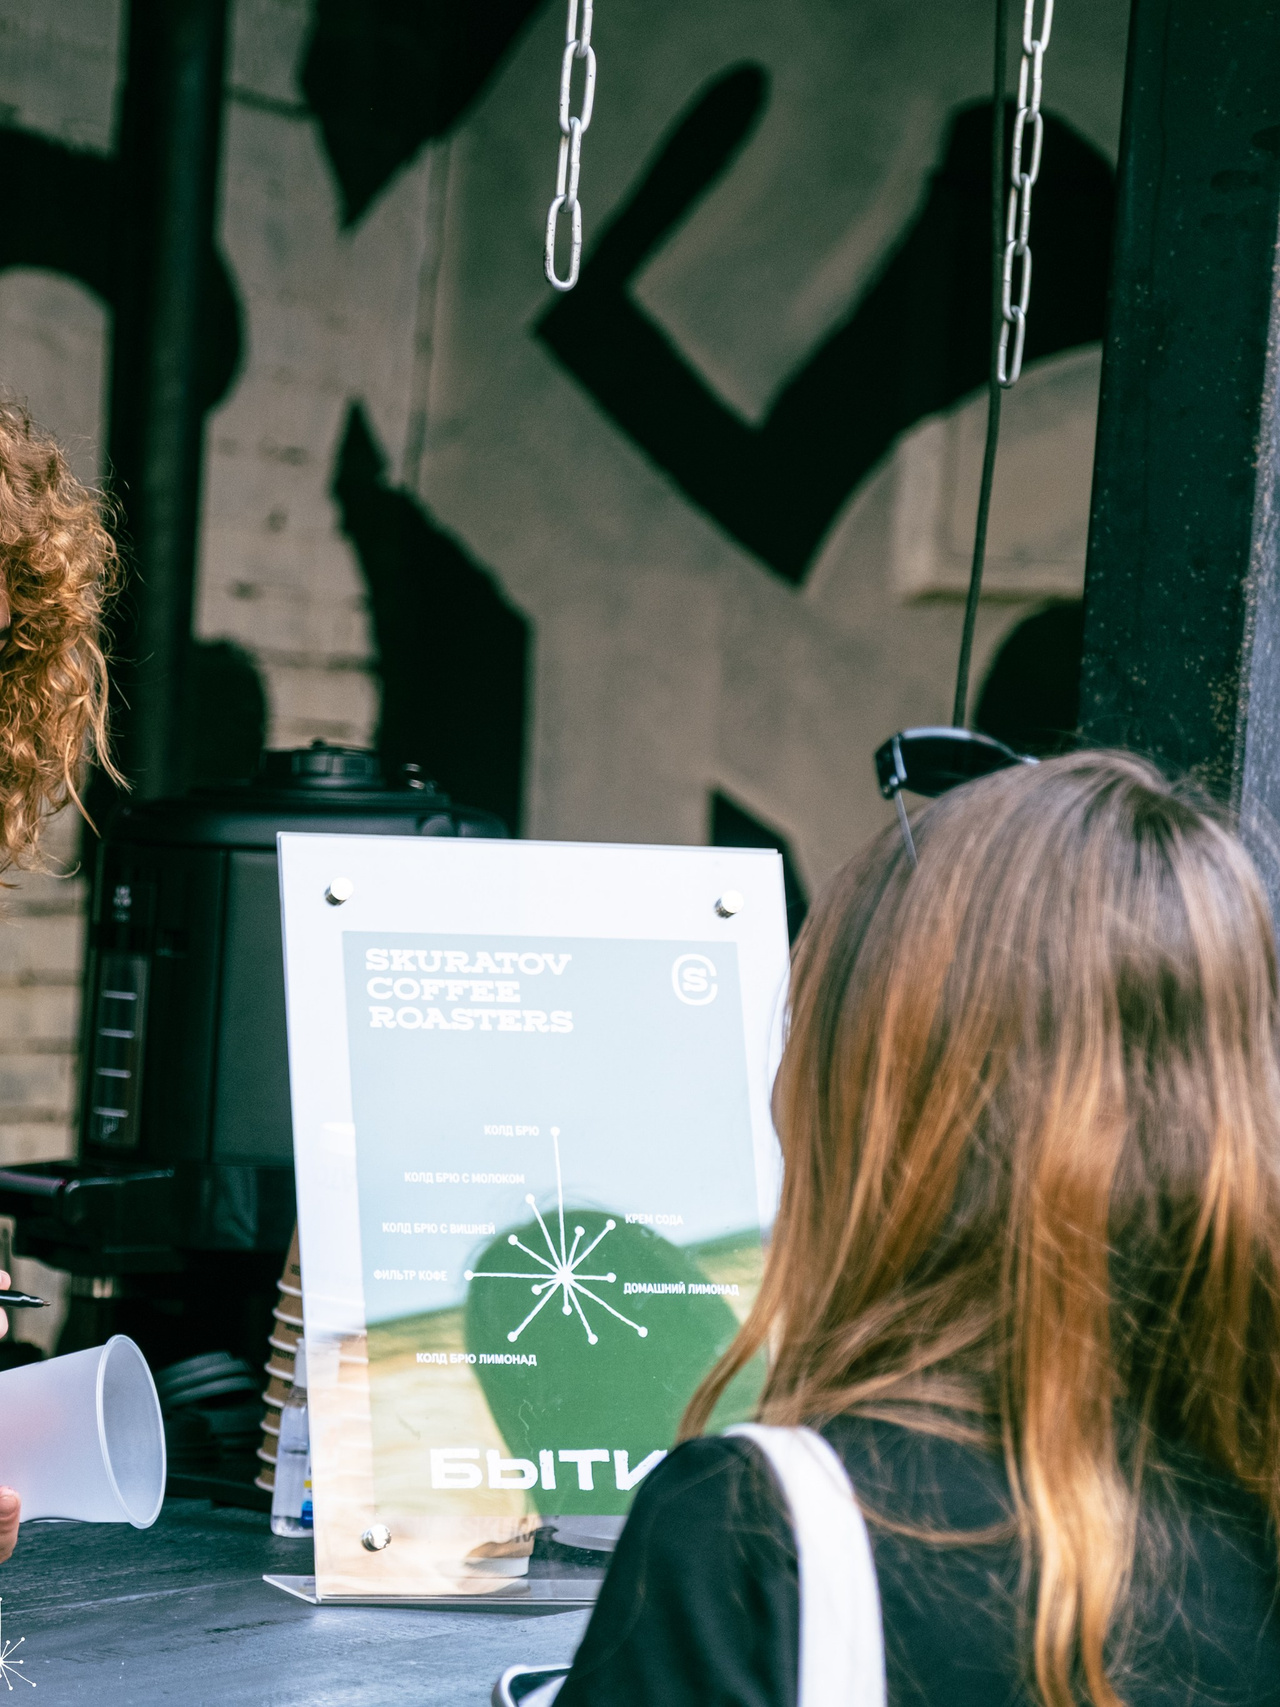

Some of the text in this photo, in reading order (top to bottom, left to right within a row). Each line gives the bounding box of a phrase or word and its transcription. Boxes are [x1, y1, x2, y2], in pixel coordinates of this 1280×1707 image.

[365, 948, 572, 976] SKURATOV
[366, 977, 521, 1003] COFFEE
[368, 1005, 574, 1034] ROASTERS
[483, 1125, 540, 1137] КОЛД БРЮ
[404, 1172, 525, 1184] КОЛД БРЮ С МОЛОКОМ
[625, 1213, 684, 1226] КРЕМ СОДА
[382, 1222, 496, 1235] КОЛД БРЮ С ВИШНЕЙ
[373, 1269, 448, 1281] ФИЛЬТР КОФЕ
[623, 1281, 740, 1296] ДОМАШНИЙ ЛИМОНАД
[416, 1352, 538, 1366] КОЛД БРЮ ЛИМОНАД
